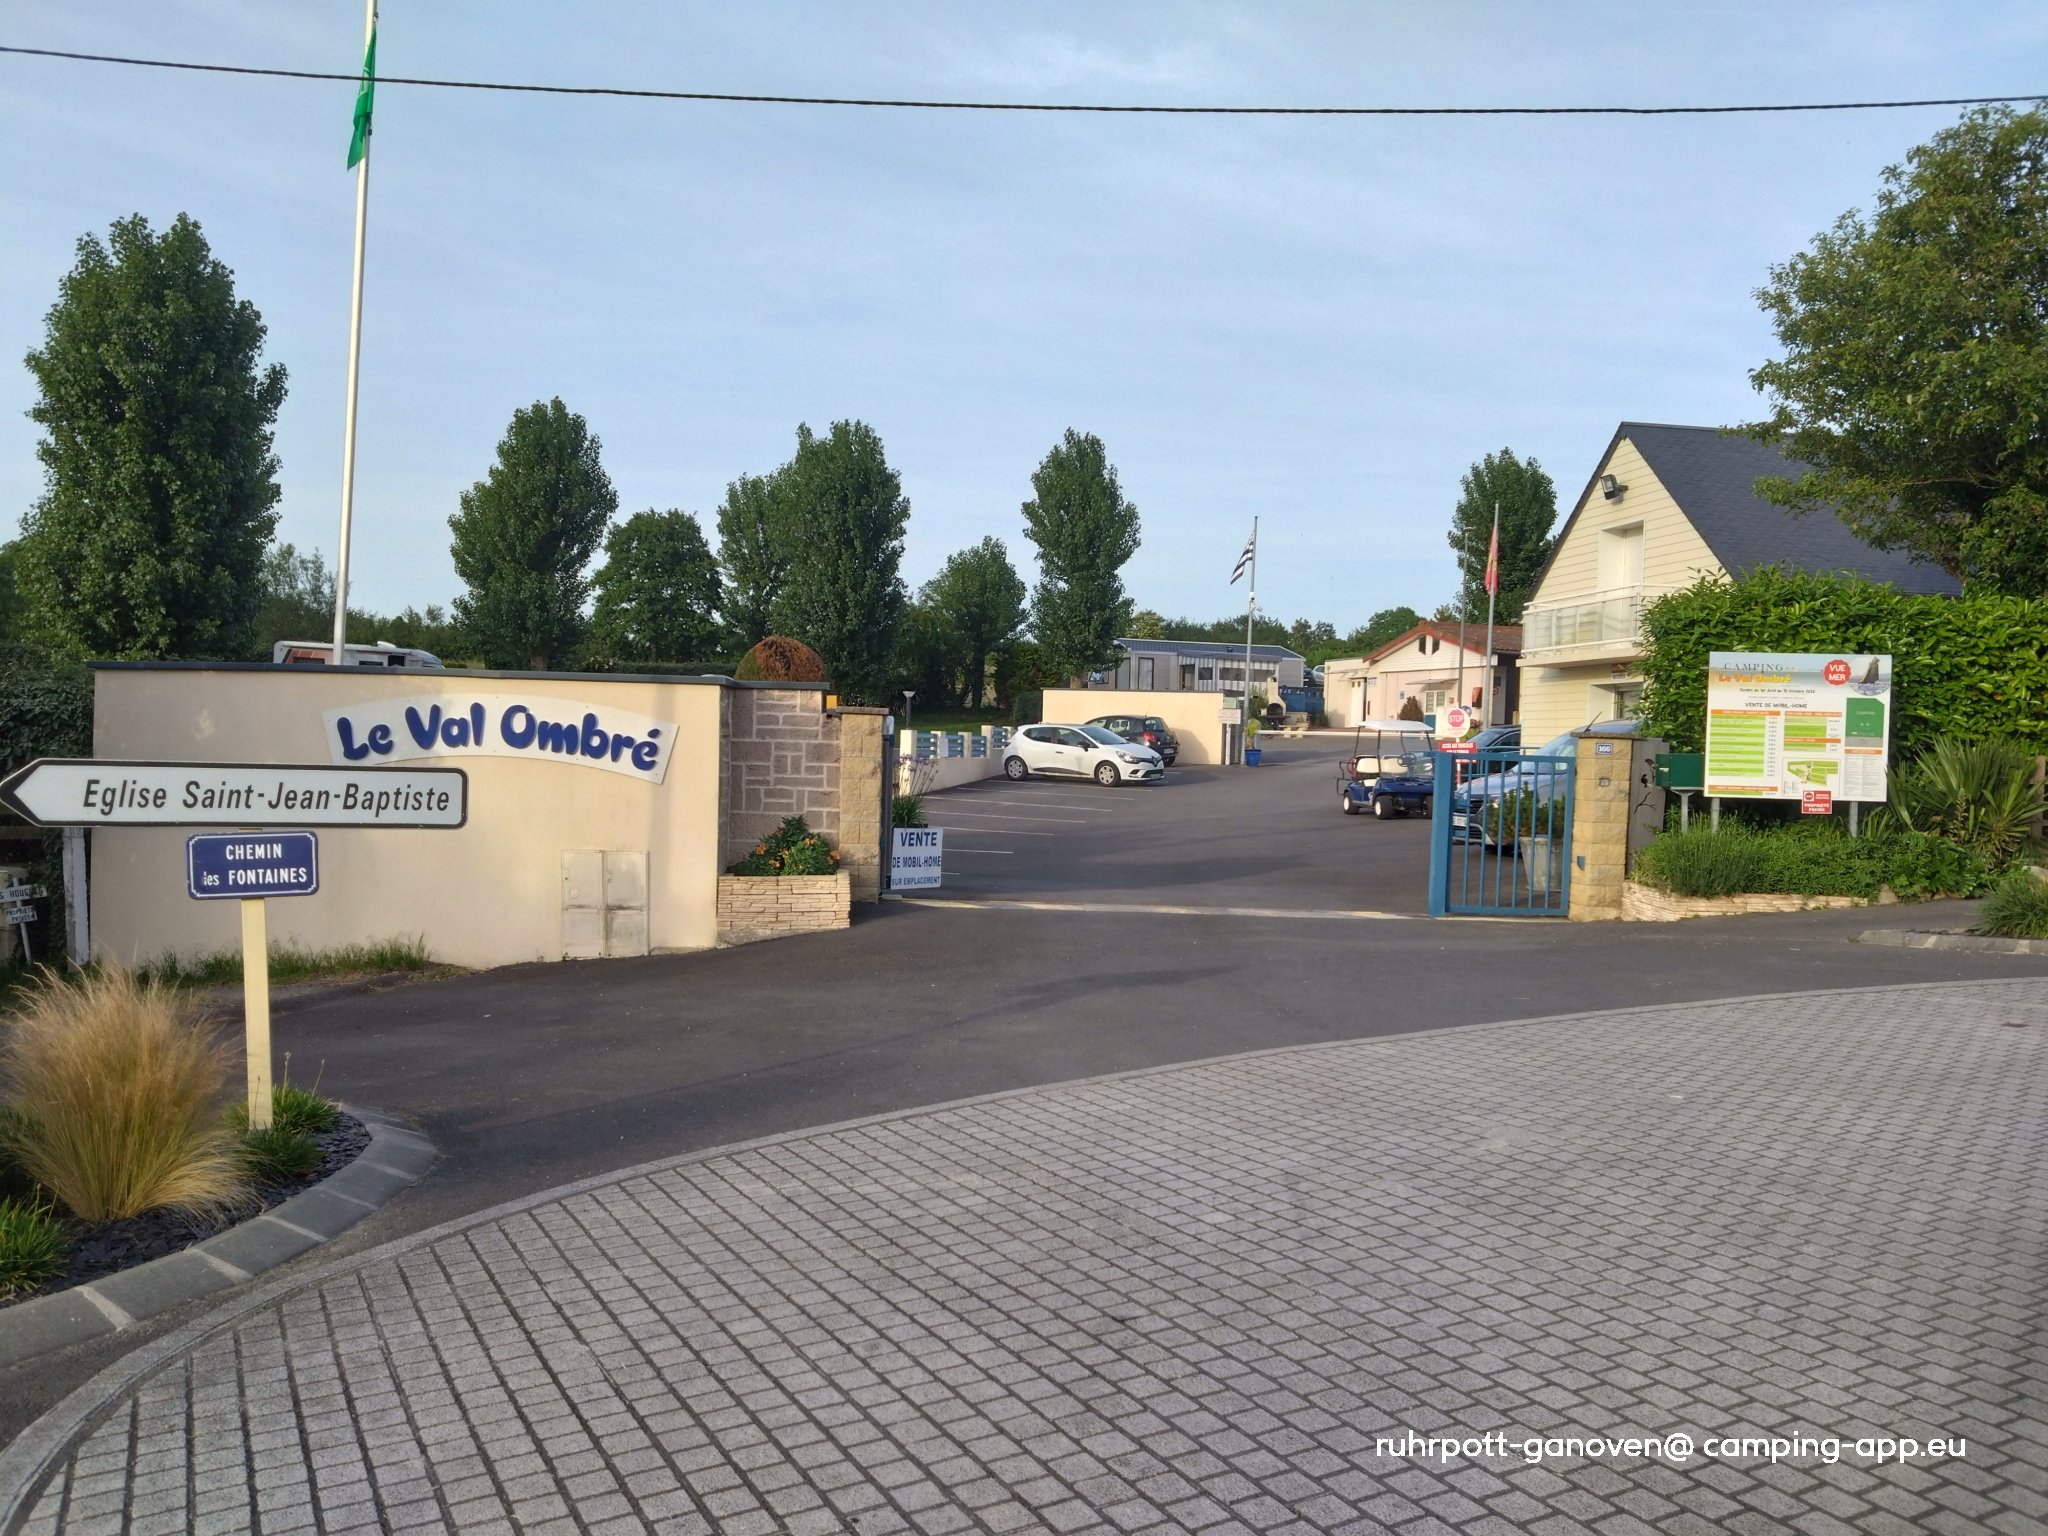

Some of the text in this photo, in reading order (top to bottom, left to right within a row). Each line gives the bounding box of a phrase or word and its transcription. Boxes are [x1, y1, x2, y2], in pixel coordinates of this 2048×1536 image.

[1724, 663, 1784, 673] CAMPING
[1830, 664, 1846, 672] VUE
[1828, 673, 1846, 681] MER
[1448, 714, 1464, 723] STOP
[336, 702, 661, 772] Le Val Ombré
[83, 779, 450, 817] Eglise Saint-Jean-Baptiste
[900, 831, 938, 847] VENTE
[225, 843, 283, 861] CHEMIN
[892, 855, 942, 868] DE MOBIL-HOME
[228, 867, 307, 886] FONTAINES
[891, 876, 941, 886] SUR EMPLACEMENT
